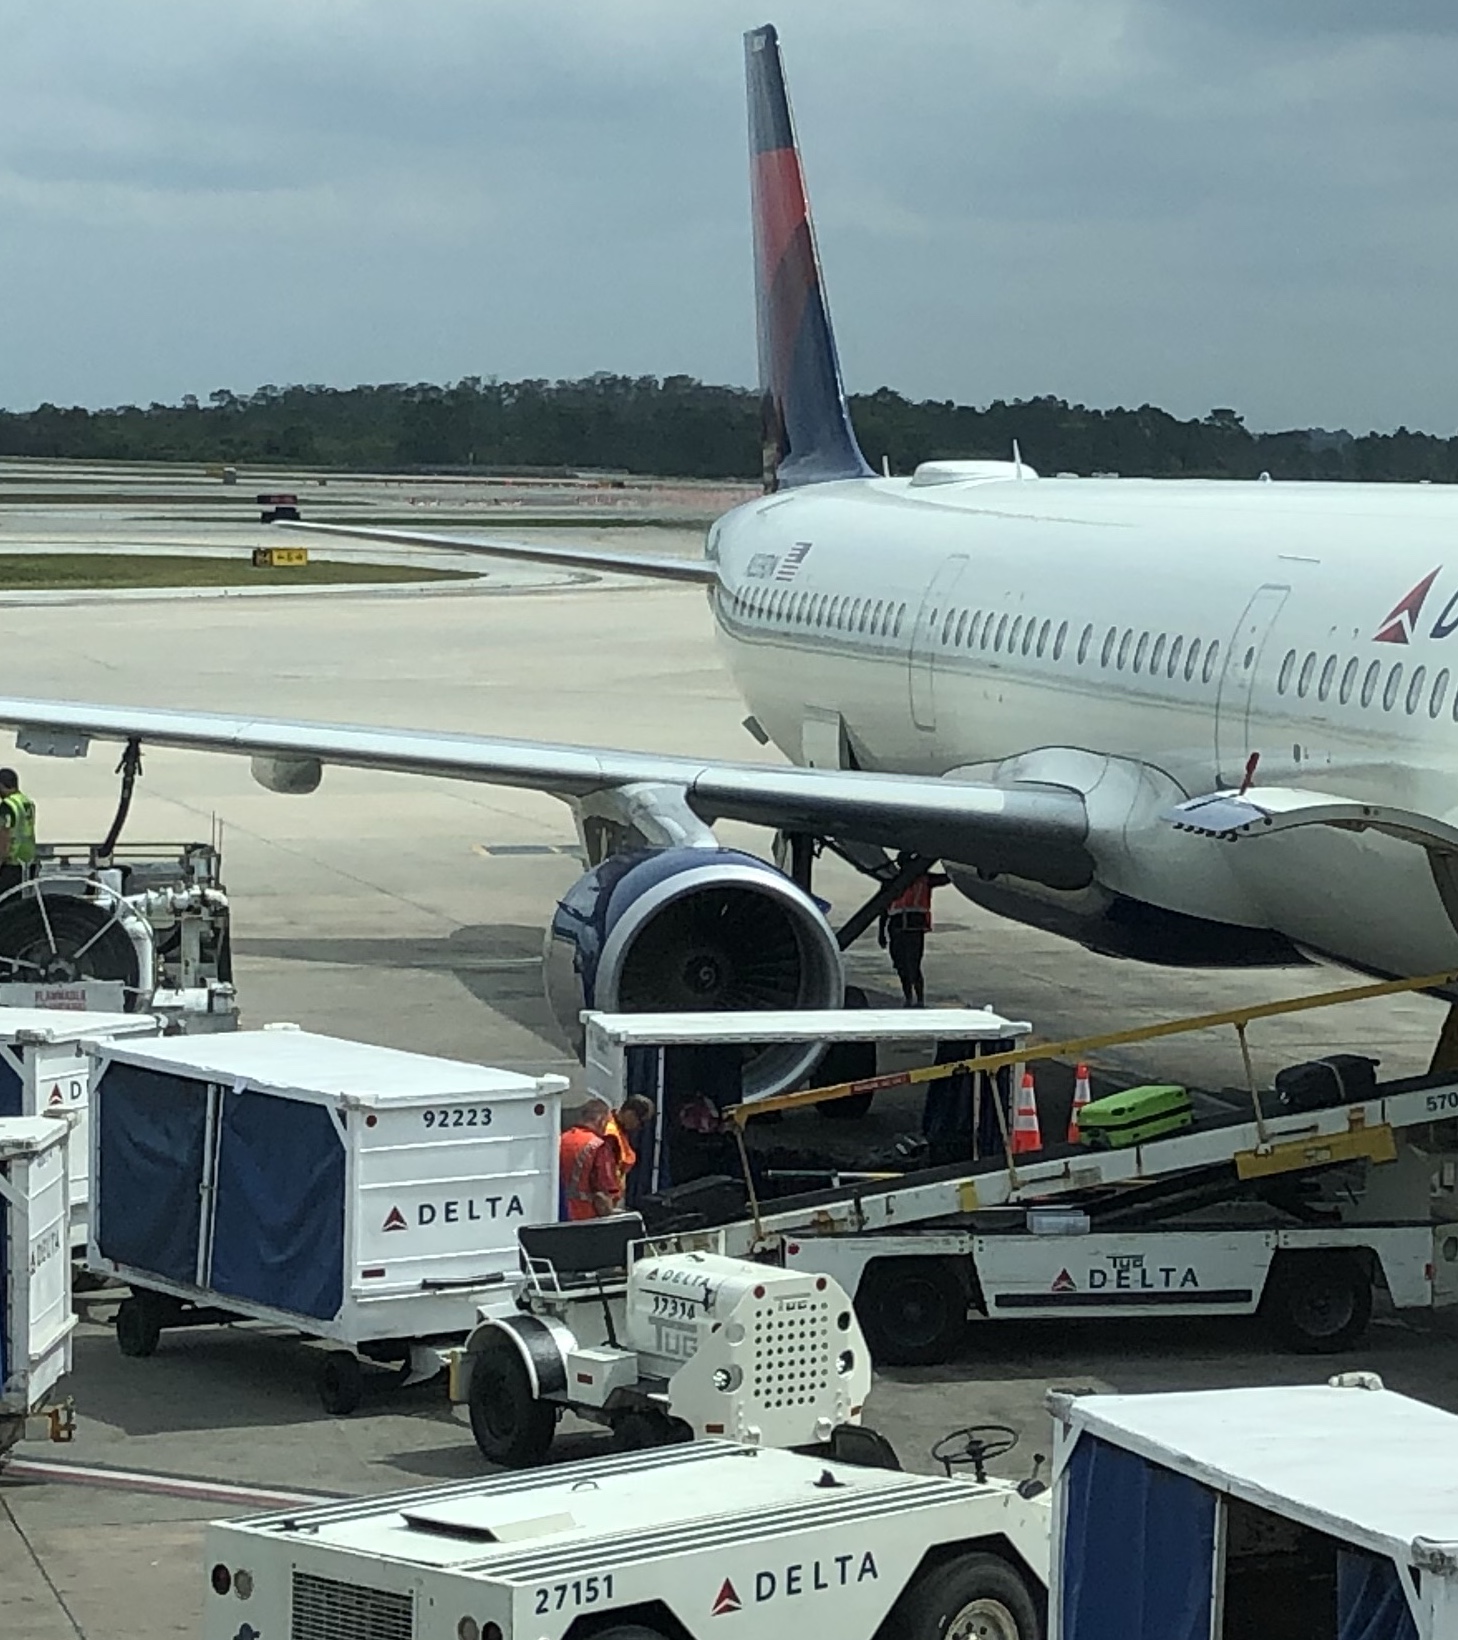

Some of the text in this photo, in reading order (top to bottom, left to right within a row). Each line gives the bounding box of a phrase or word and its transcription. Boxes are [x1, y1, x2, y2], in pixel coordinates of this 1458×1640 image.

[423, 1108, 493, 1128] 92223
[418, 1195, 524, 1226] DELTA
[661, 1269, 711, 1288] DELTA
[1089, 1267, 1199, 1289] DELTA
[755, 1551, 879, 1603] DELTA
[535, 1574, 614, 1615] 27151
